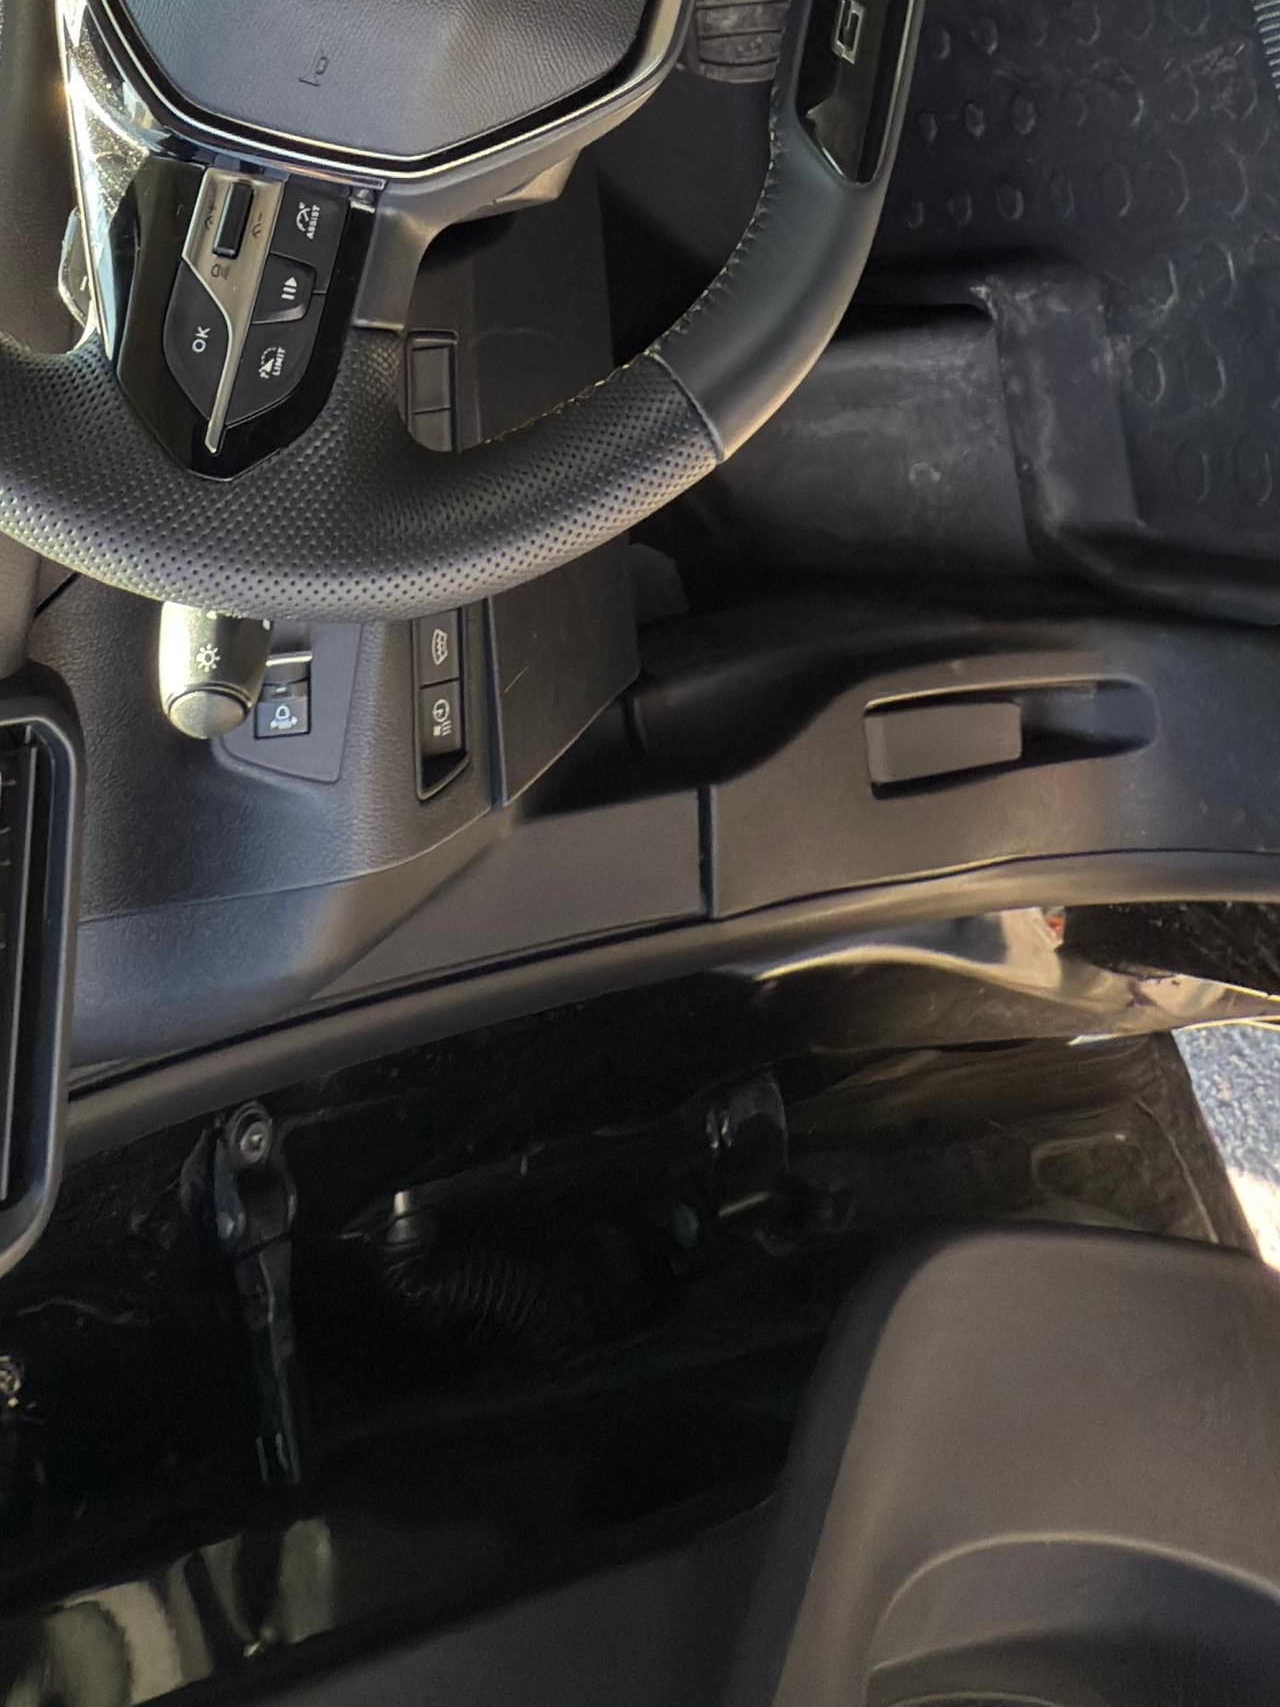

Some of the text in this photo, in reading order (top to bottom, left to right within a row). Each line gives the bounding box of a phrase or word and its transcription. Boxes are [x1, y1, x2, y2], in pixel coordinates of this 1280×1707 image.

[306, 204, 321, 240] ASSIST
[191, 326, 211, 353] OK
[272, 347, 286, 376] LIMIT
